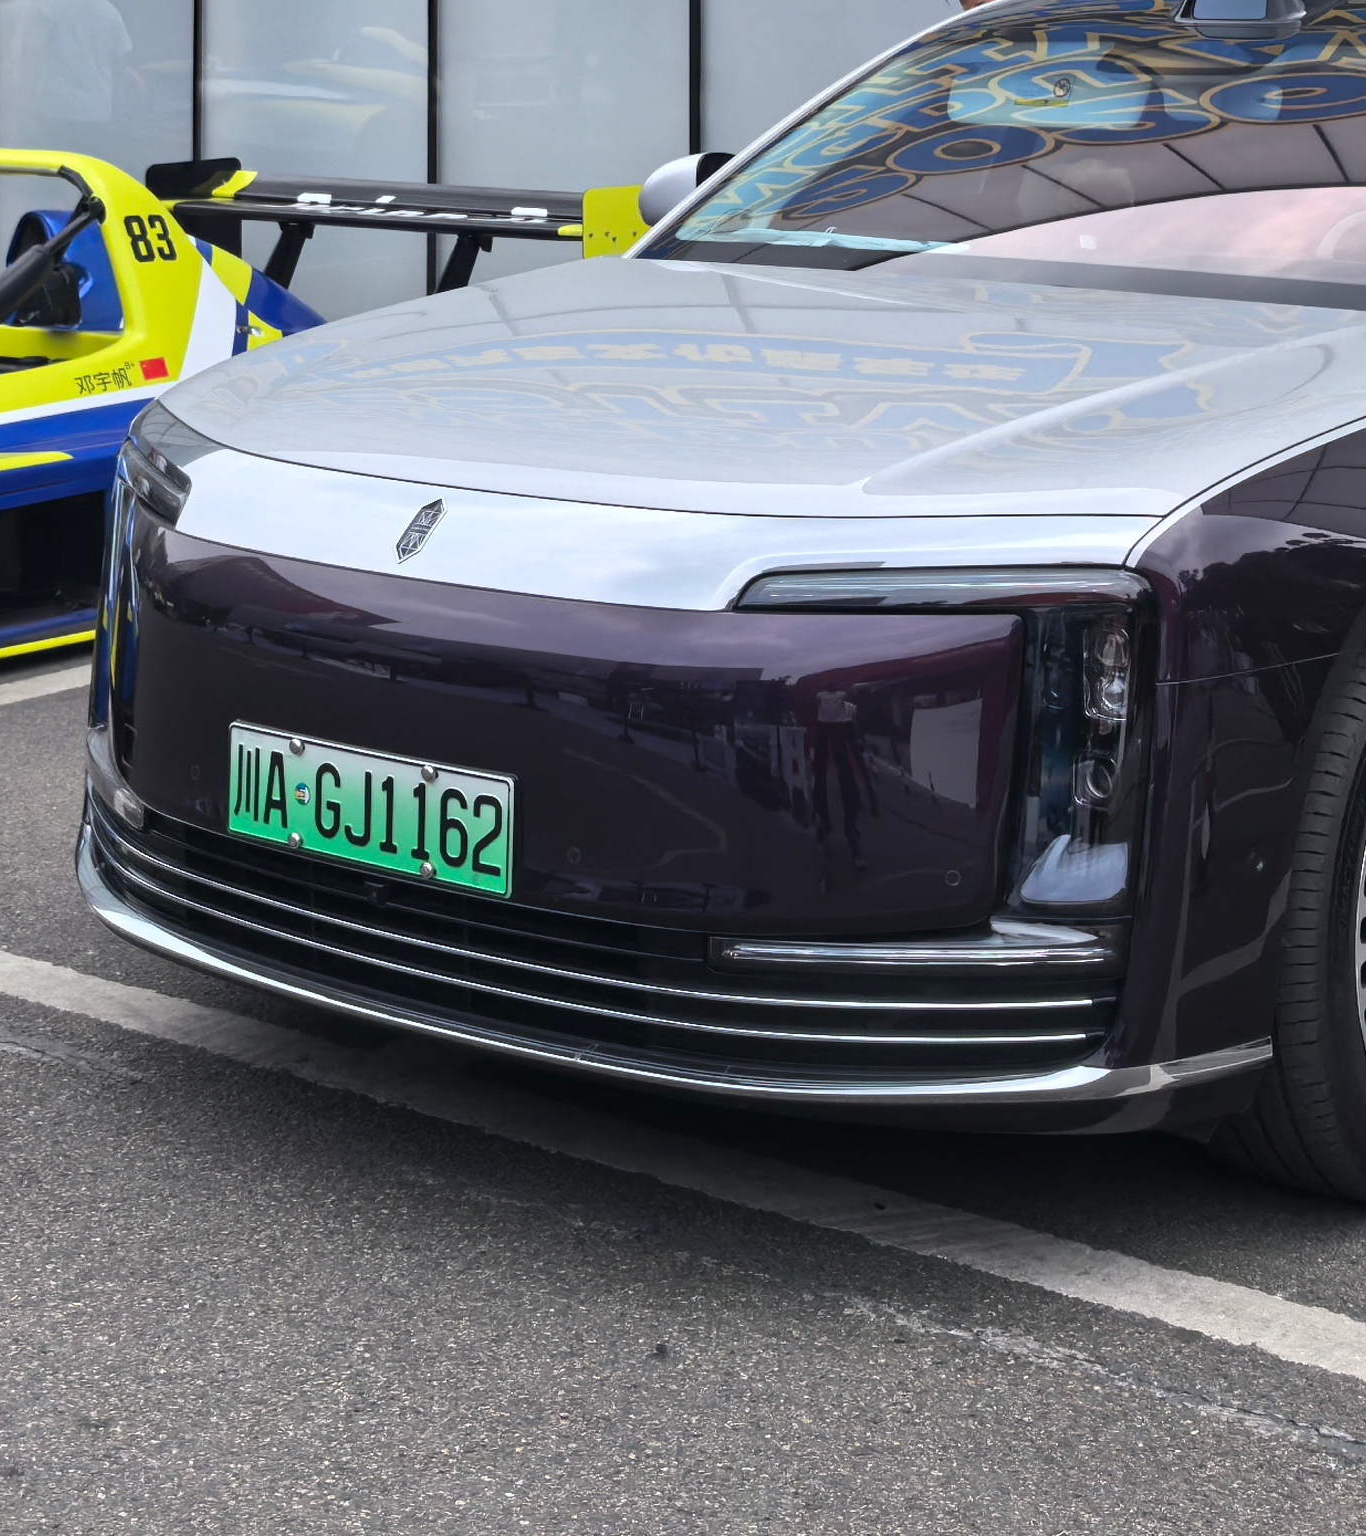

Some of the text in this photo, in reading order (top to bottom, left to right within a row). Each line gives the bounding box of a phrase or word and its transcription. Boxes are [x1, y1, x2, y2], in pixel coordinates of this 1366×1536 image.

[124, 215, 176, 262] 83
[74, 367, 132, 395] 邓宇帆
